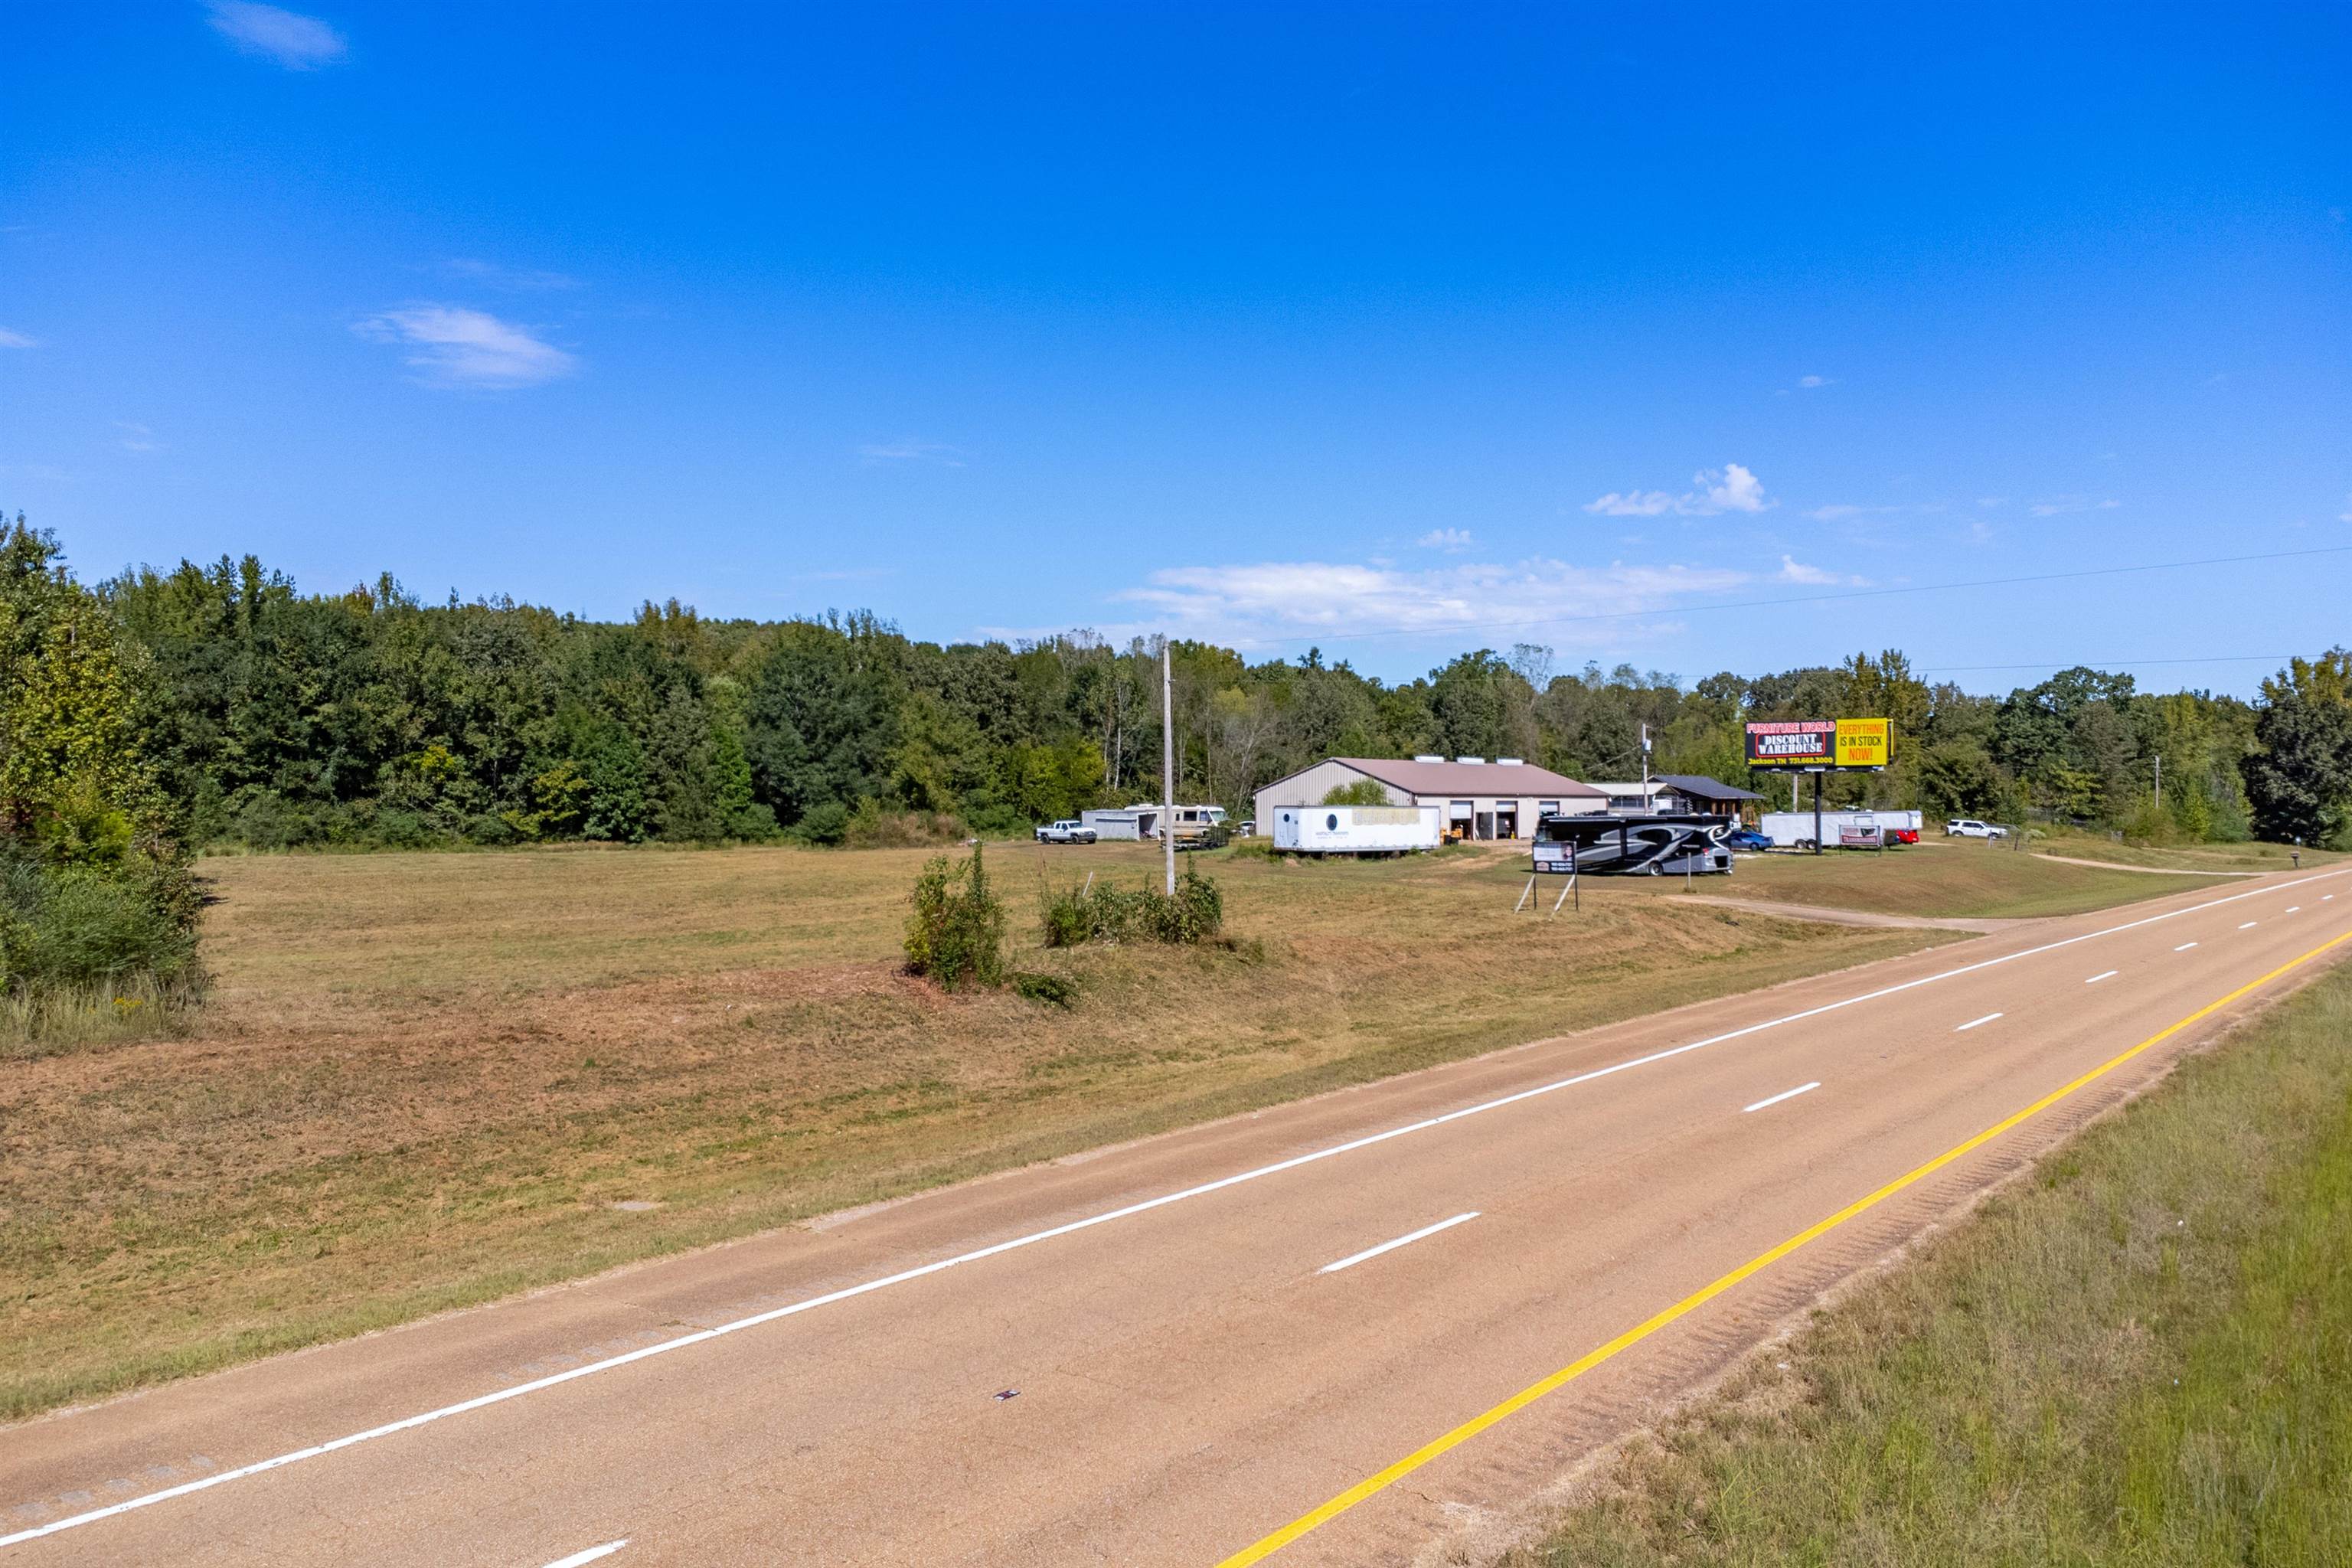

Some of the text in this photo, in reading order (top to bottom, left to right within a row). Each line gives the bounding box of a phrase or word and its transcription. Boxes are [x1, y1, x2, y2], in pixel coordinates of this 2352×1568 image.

[1746, 721, 1836, 733] FURNITURE WORLD
[1838, 724, 1884, 735] EVERYTHING
[1764, 733, 1817, 745] DISCOUNT
[1840, 736, 1882, 746] IS IN STOCK
[1758, 743, 1823, 754] WAREHOUSE
[1849, 748, 1873, 760] NOW!
